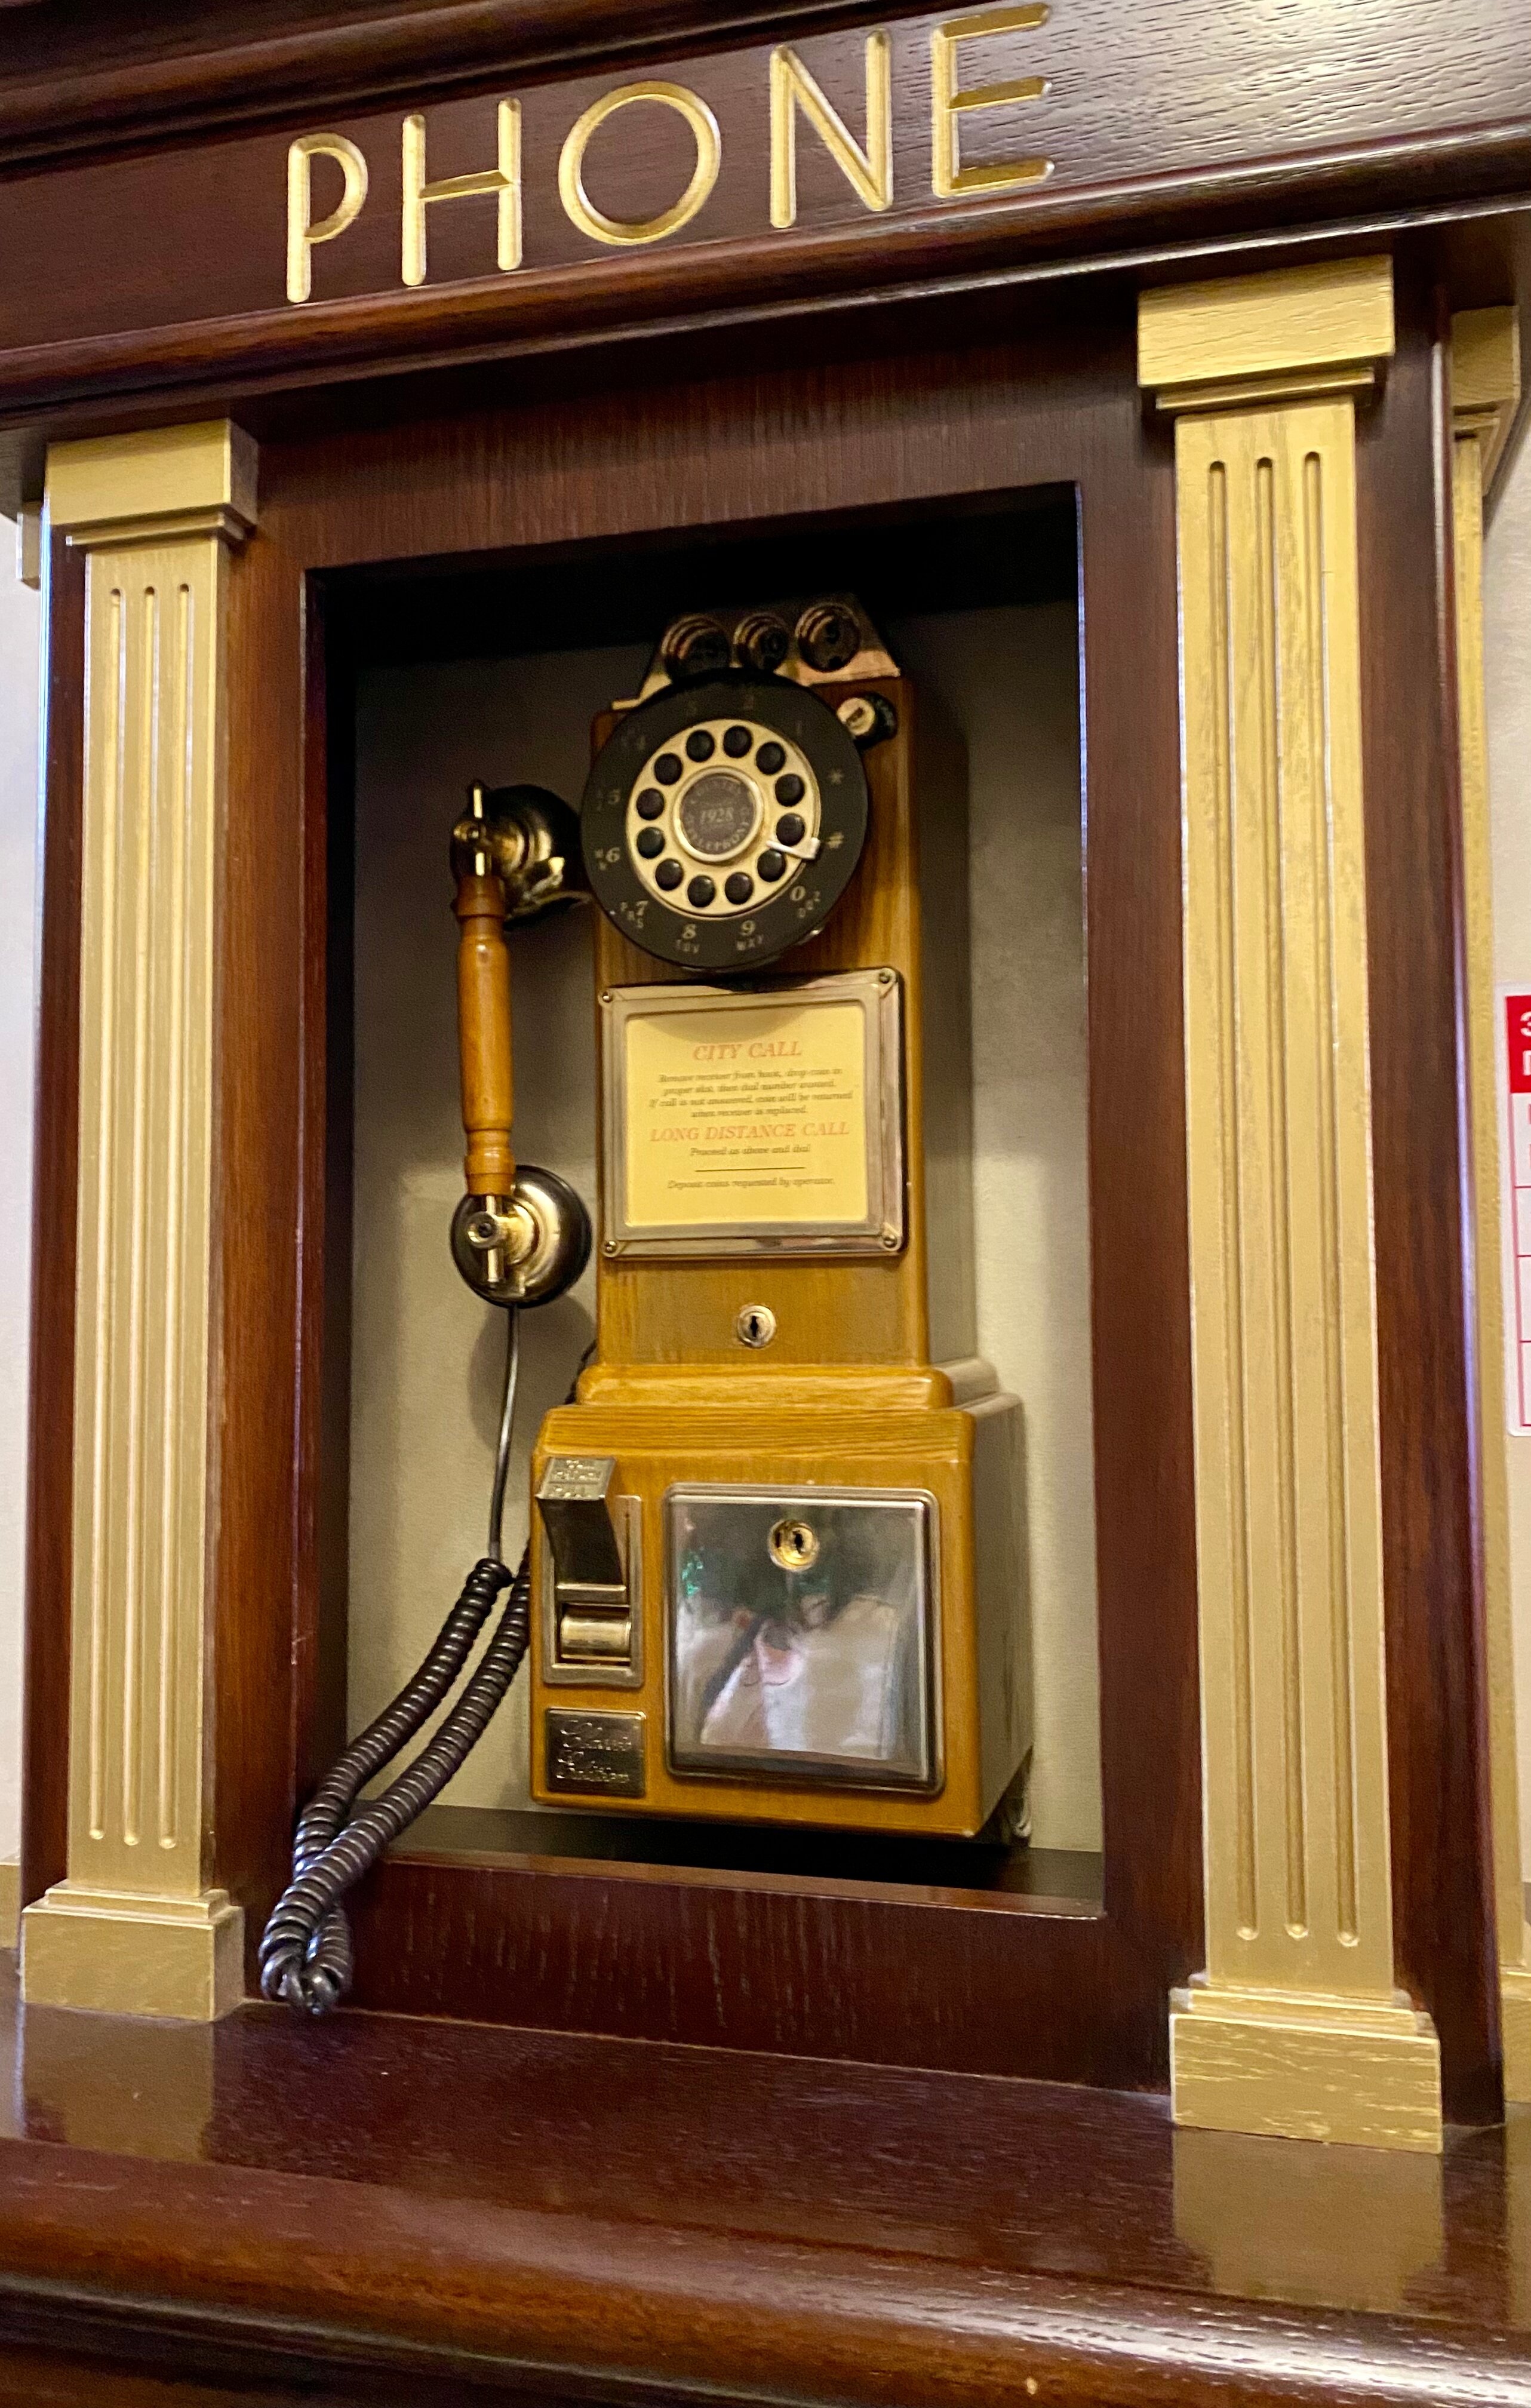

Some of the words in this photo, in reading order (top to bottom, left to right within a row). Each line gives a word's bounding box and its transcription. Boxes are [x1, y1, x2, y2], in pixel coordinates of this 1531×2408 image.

[287, 2, 1055, 303] PHONE
[700, 806, 735, 825] 1928
[606, 847, 620, 863] 6
[635, 899, 649, 916] 7
[681, 923, 697, 939] 8
[740, 920, 756, 936] 9
[692, 1044, 743, 1061] CITY
[748, 1041, 802, 1058] CALL
[650, 1127, 699, 1141] LONG
[705, 1123, 796, 1140] DISTANCE
[802, 1122, 850, 1136] CALL
